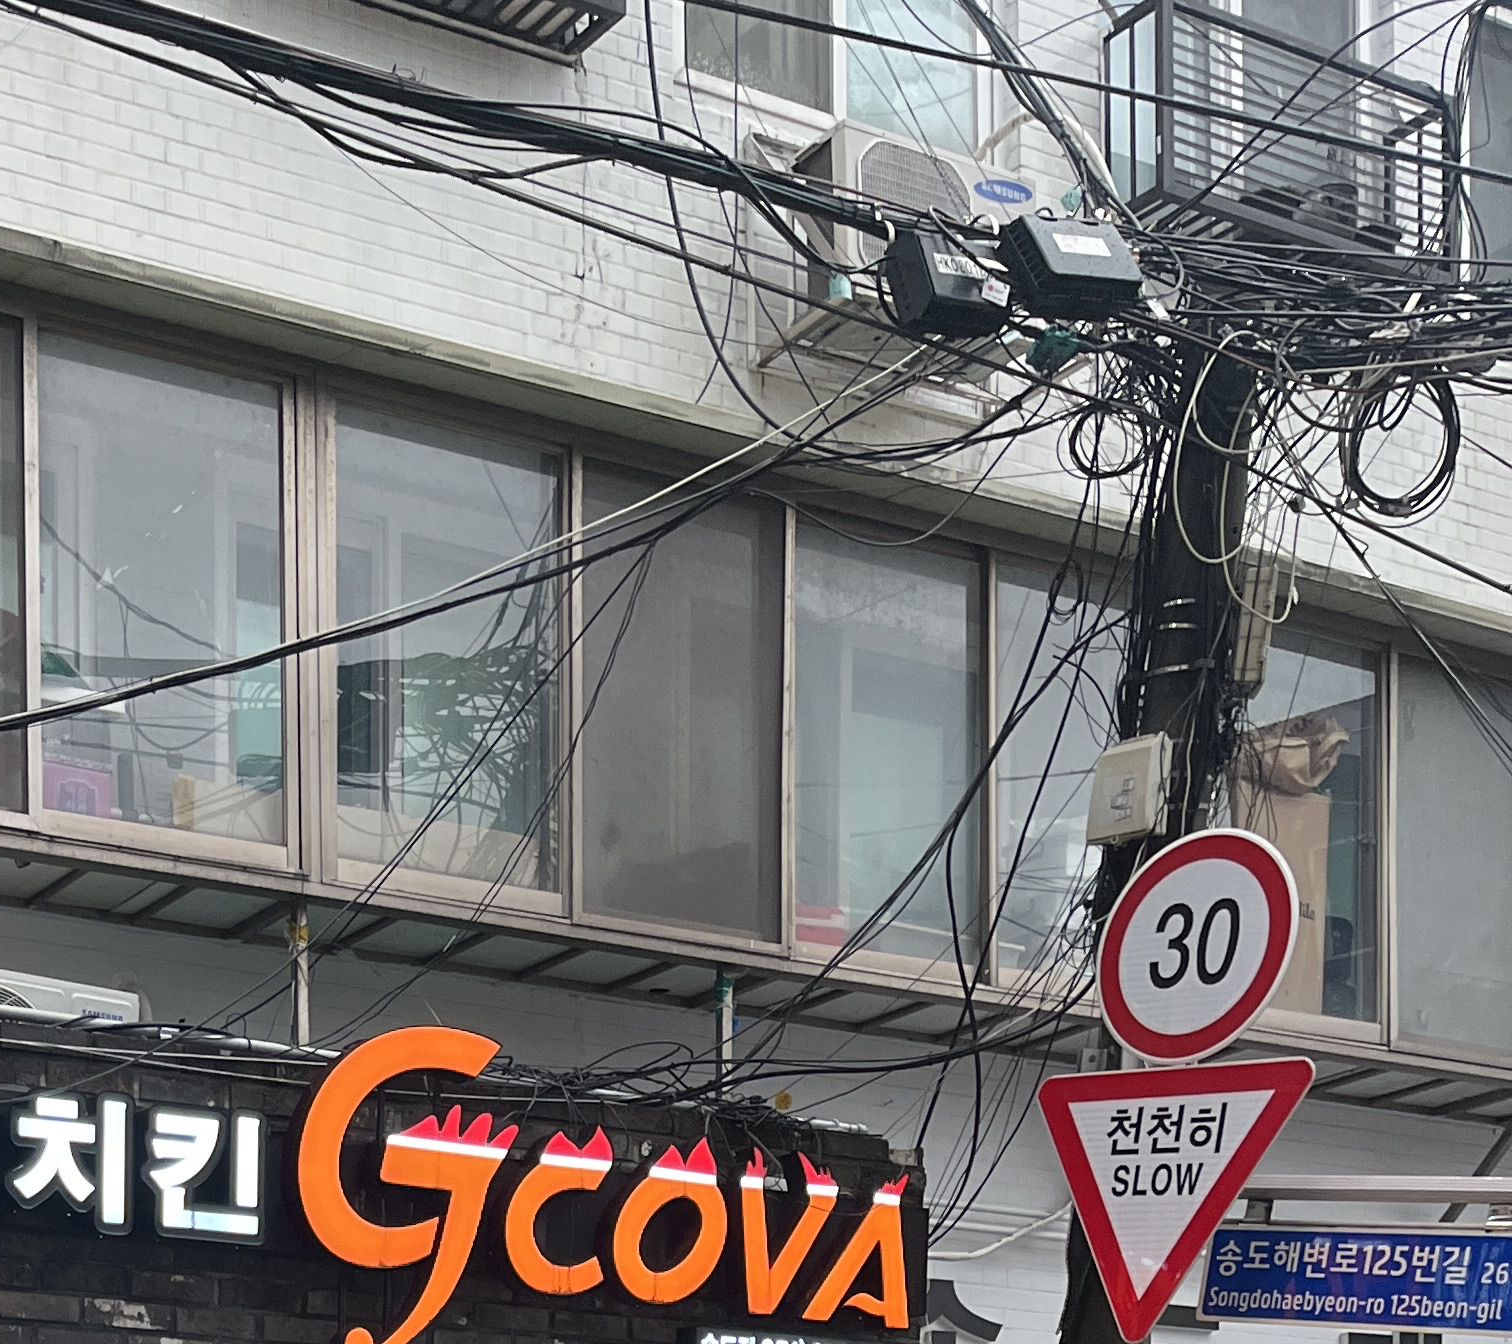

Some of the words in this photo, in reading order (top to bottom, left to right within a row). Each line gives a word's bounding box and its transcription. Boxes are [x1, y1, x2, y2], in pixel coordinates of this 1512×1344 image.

[1149, 898, 1240, 989] 30
[1107, 1102, 1228, 1156] 천천히
[13, 1097, 261, 1236] 치킨
[1111, 1162, 1204, 1197] SLOW
[1216, 1239, 1472, 1286] 송도해변로125번길
[1481, 1262, 1509, 1285] 26
[1208, 1286, 1385, 1316] Songdohaebyeon-ro
[1390, 1294, 1503, 1324] 125beon-gil
